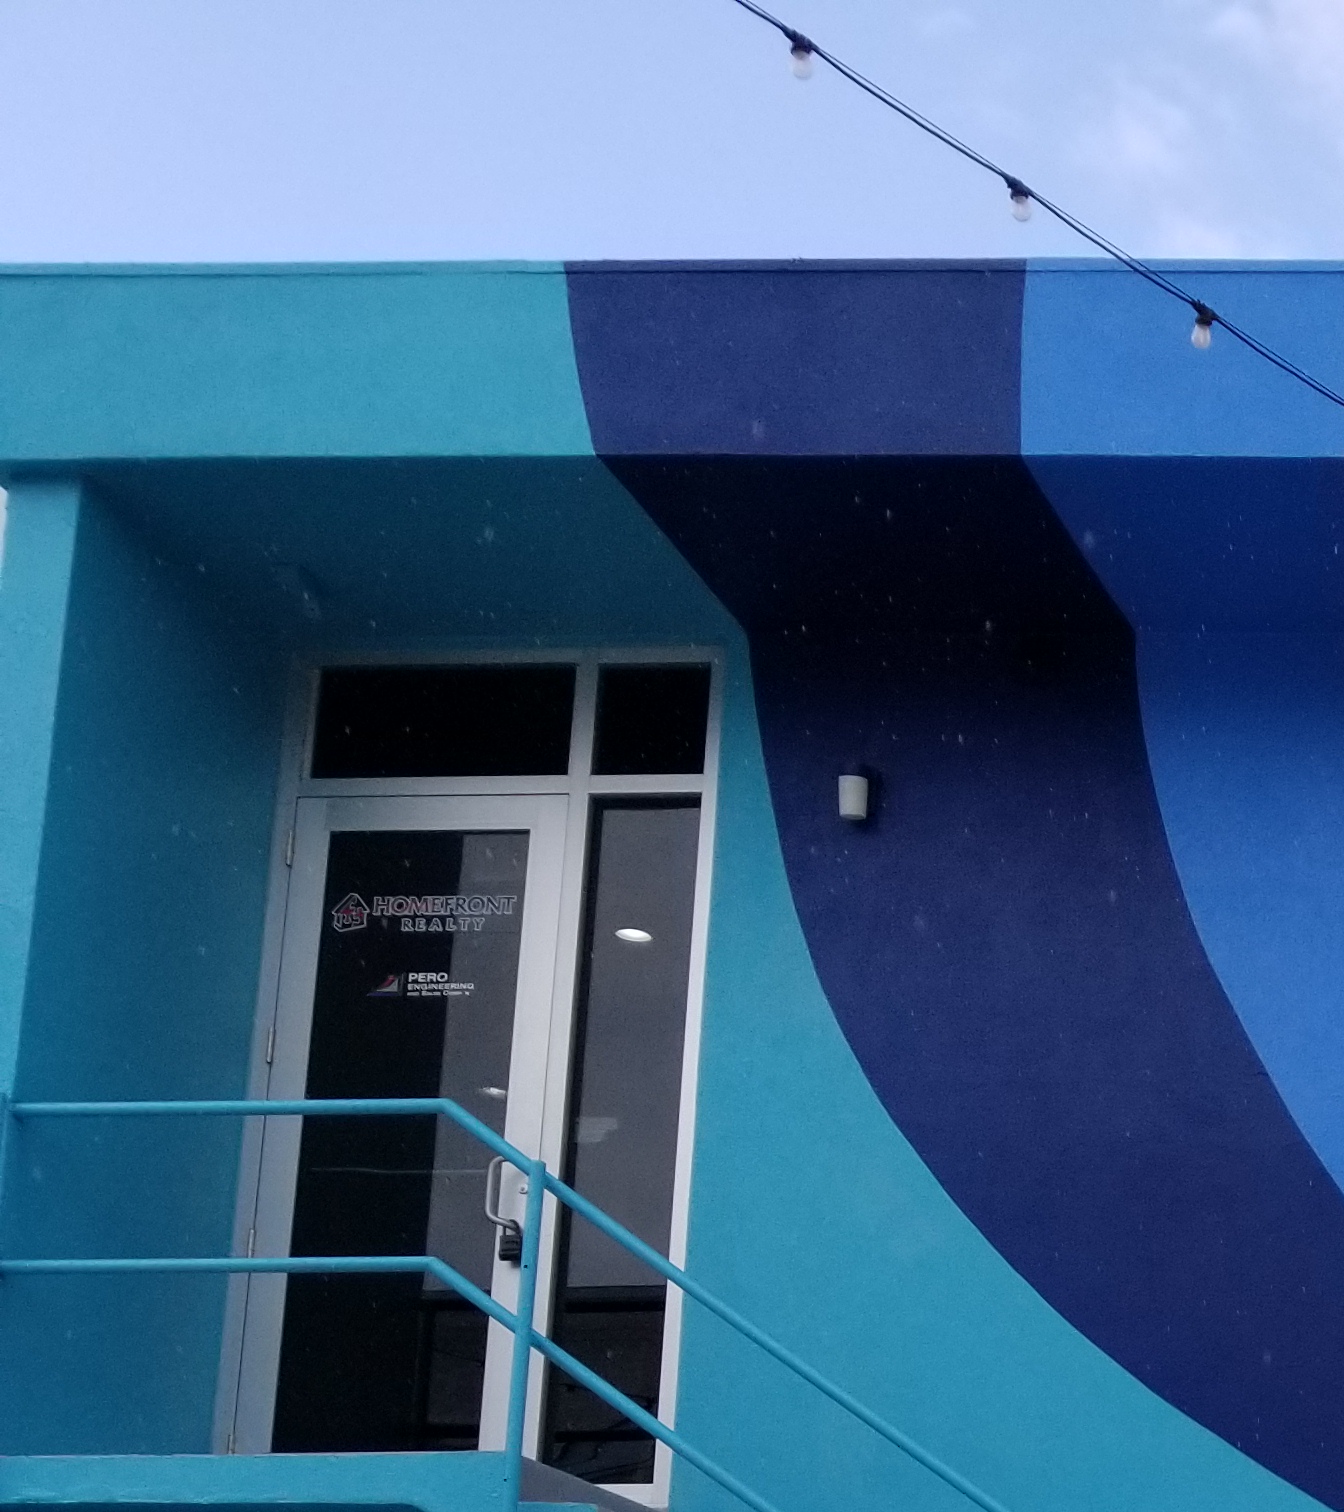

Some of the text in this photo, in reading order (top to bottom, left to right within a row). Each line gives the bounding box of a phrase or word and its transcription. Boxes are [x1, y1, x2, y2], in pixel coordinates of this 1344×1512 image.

[372, 895, 517, 916] HOMEFRONT
[400, 917, 486, 932] REALTY
[407, 971, 449, 983] PERO
[406, 982, 475, 991] ENGINEERING
